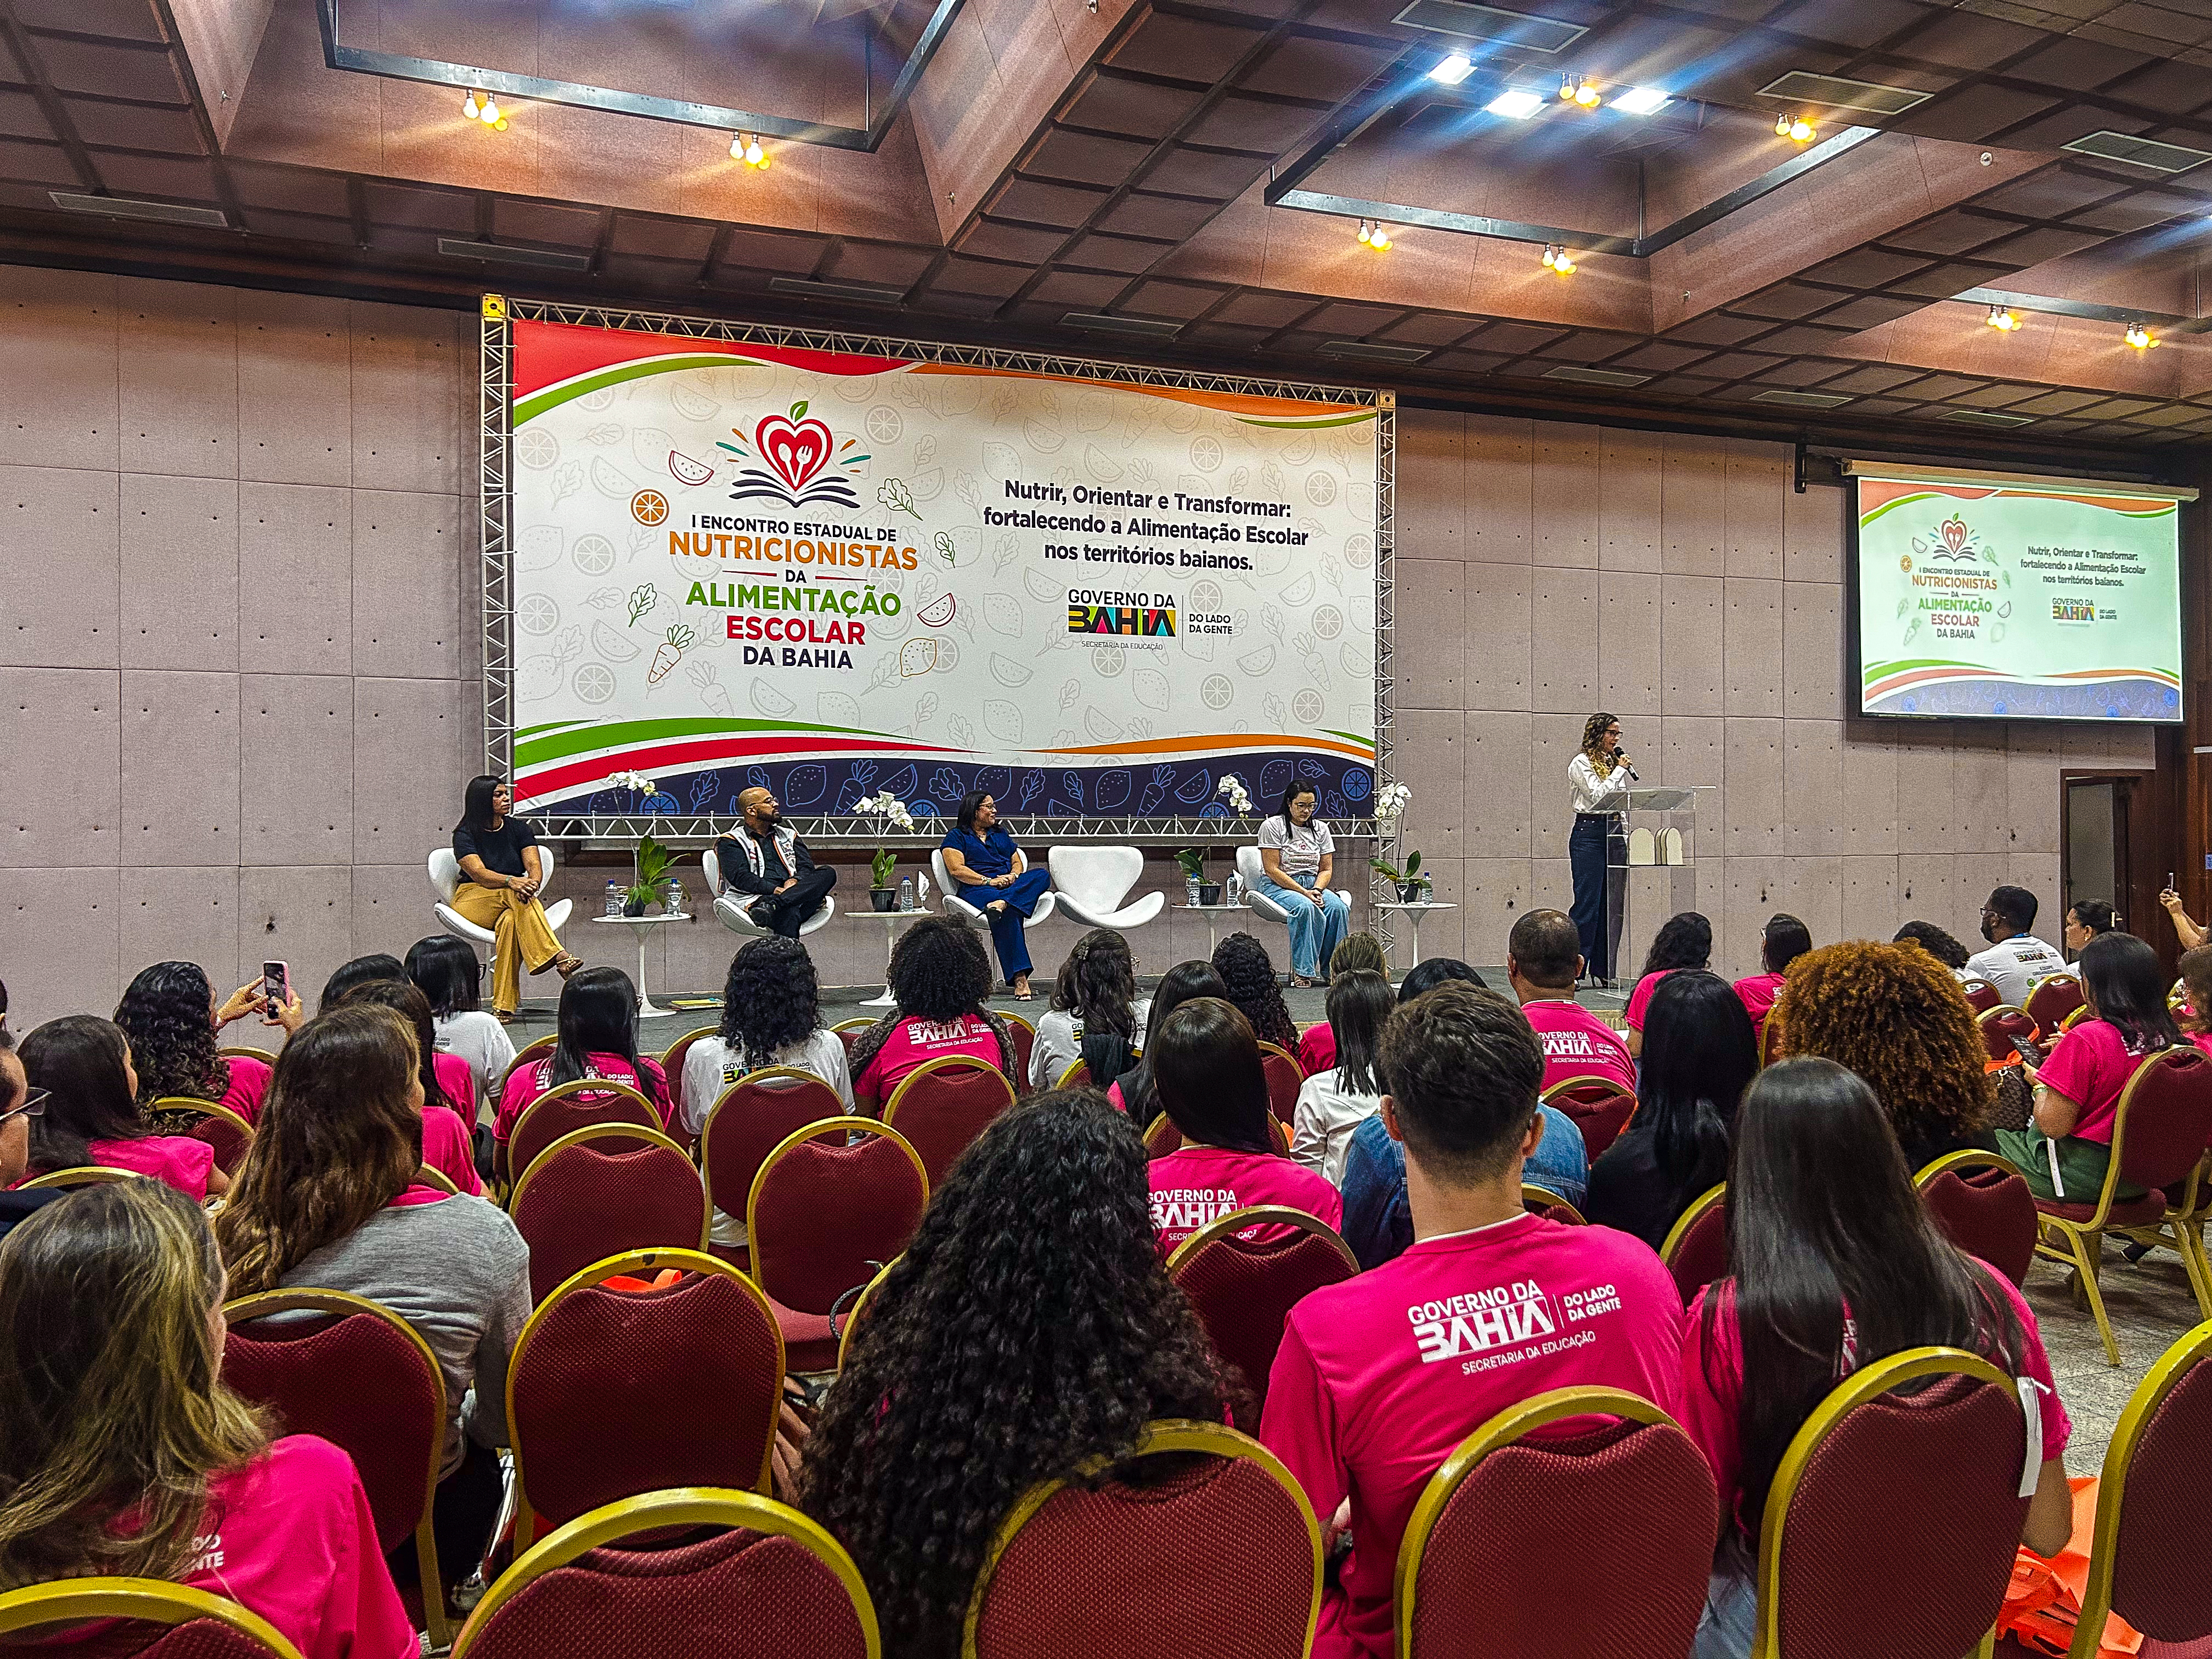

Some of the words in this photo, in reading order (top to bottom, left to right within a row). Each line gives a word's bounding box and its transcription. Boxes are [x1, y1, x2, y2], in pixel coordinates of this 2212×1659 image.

[1005, 479, 1067, 505] Nutrir,
[1073, 485, 1152, 509] Orientar
[1159, 496, 1169, 510] e
[1174, 493, 1291, 518] Transformar:
[692, 515, 696, 528] I
[701, 515, 789, 534] ENCONTRO
[794, 522, 872, 540] ESTADUAL
[878, 528, 896, 542] DE
[984, 507, 1105, 534] fortalecendo
[1110, 521, 1121, 535] a
[1127, 518, 1240, 544] Alimentação
[1246, 526, 1308, 546] Escolar
[669, 531, 918, 571] NUTRICIONISTAS
[1045, 543, 1077, 561] nos
[1084, 543, 1174, 567] territórios
[1180, 549, 1253, 571] baianos.
[2028, 546, 2051, 557] Nutrir,
[2053, 548, 2084, 557] Orientar
[2021, 559, 2066, 570] fortalecendo
[2074, 562, 2119, 574] Alimentação
[2121, 565, 2146, 574] Escolar
[786, 569, 806, 584] DA
[1912, 574, 1997, 590] NUTRICIONISTAS
[2058, 575, 2093, 585] territórios
[686, 582, 901, 618] ALIMENTAÇÃO
[1068, 589, 1149, 607] GOVERNO
[1154, 594, 1176, 608] DA
[1918, 598, 1992, 613] ALIMENTAÇÃO
[1068, 605, 1176, 637] BAHIA
[1189, 613, 1203, 624] DO
[1205, 614, 1231, 624] LADO
[1931, 614, 1979, 627] ESCOLAR
[726, 615, 865, 645] ESCOLAR
[1189, 623, 1201, 634] DA
[1204, 624, 1233, 635] GENTE
[1937, 629, 1948, 637] DA
[1950, 629, 1975, 639] BAHIA
[1081, 640, 1119, 648] SECRETARIA
[1130, 641, 1163, 651] EDUCAÇÃO
[743, 646, 775, 666] DA
[782, 648, 853, 669] BAHIA
[907, 1020, 951, 1031] GOVER
[909, 1023, 967, 1045] BAHIA
[1538, 1031, 1576, 1040] OVERNO
[1217, 1189, 1237, 1202] DA
[1408, 1286, 1509, 1325] GOVERNO
[1511, 1279, 1544, 1300] DA
[1564, 1293, 1583, 1308] DO
[1583, 1284, 1616, 1304] LADO
[1567, 1306, 1587, 1322] DA
[1588, 1296, 1622, 1317] GENTE
[1413, 1296, 1555, 1363] BAHIA
[1462, 1350, 1525, 1376] SECRETARIA
[1526, 1346, 1541, 1358] DA
[1542, 1330, 1596, 1356] EDUCAÇÃO
[196, 1551, 224, 1570] NTE
